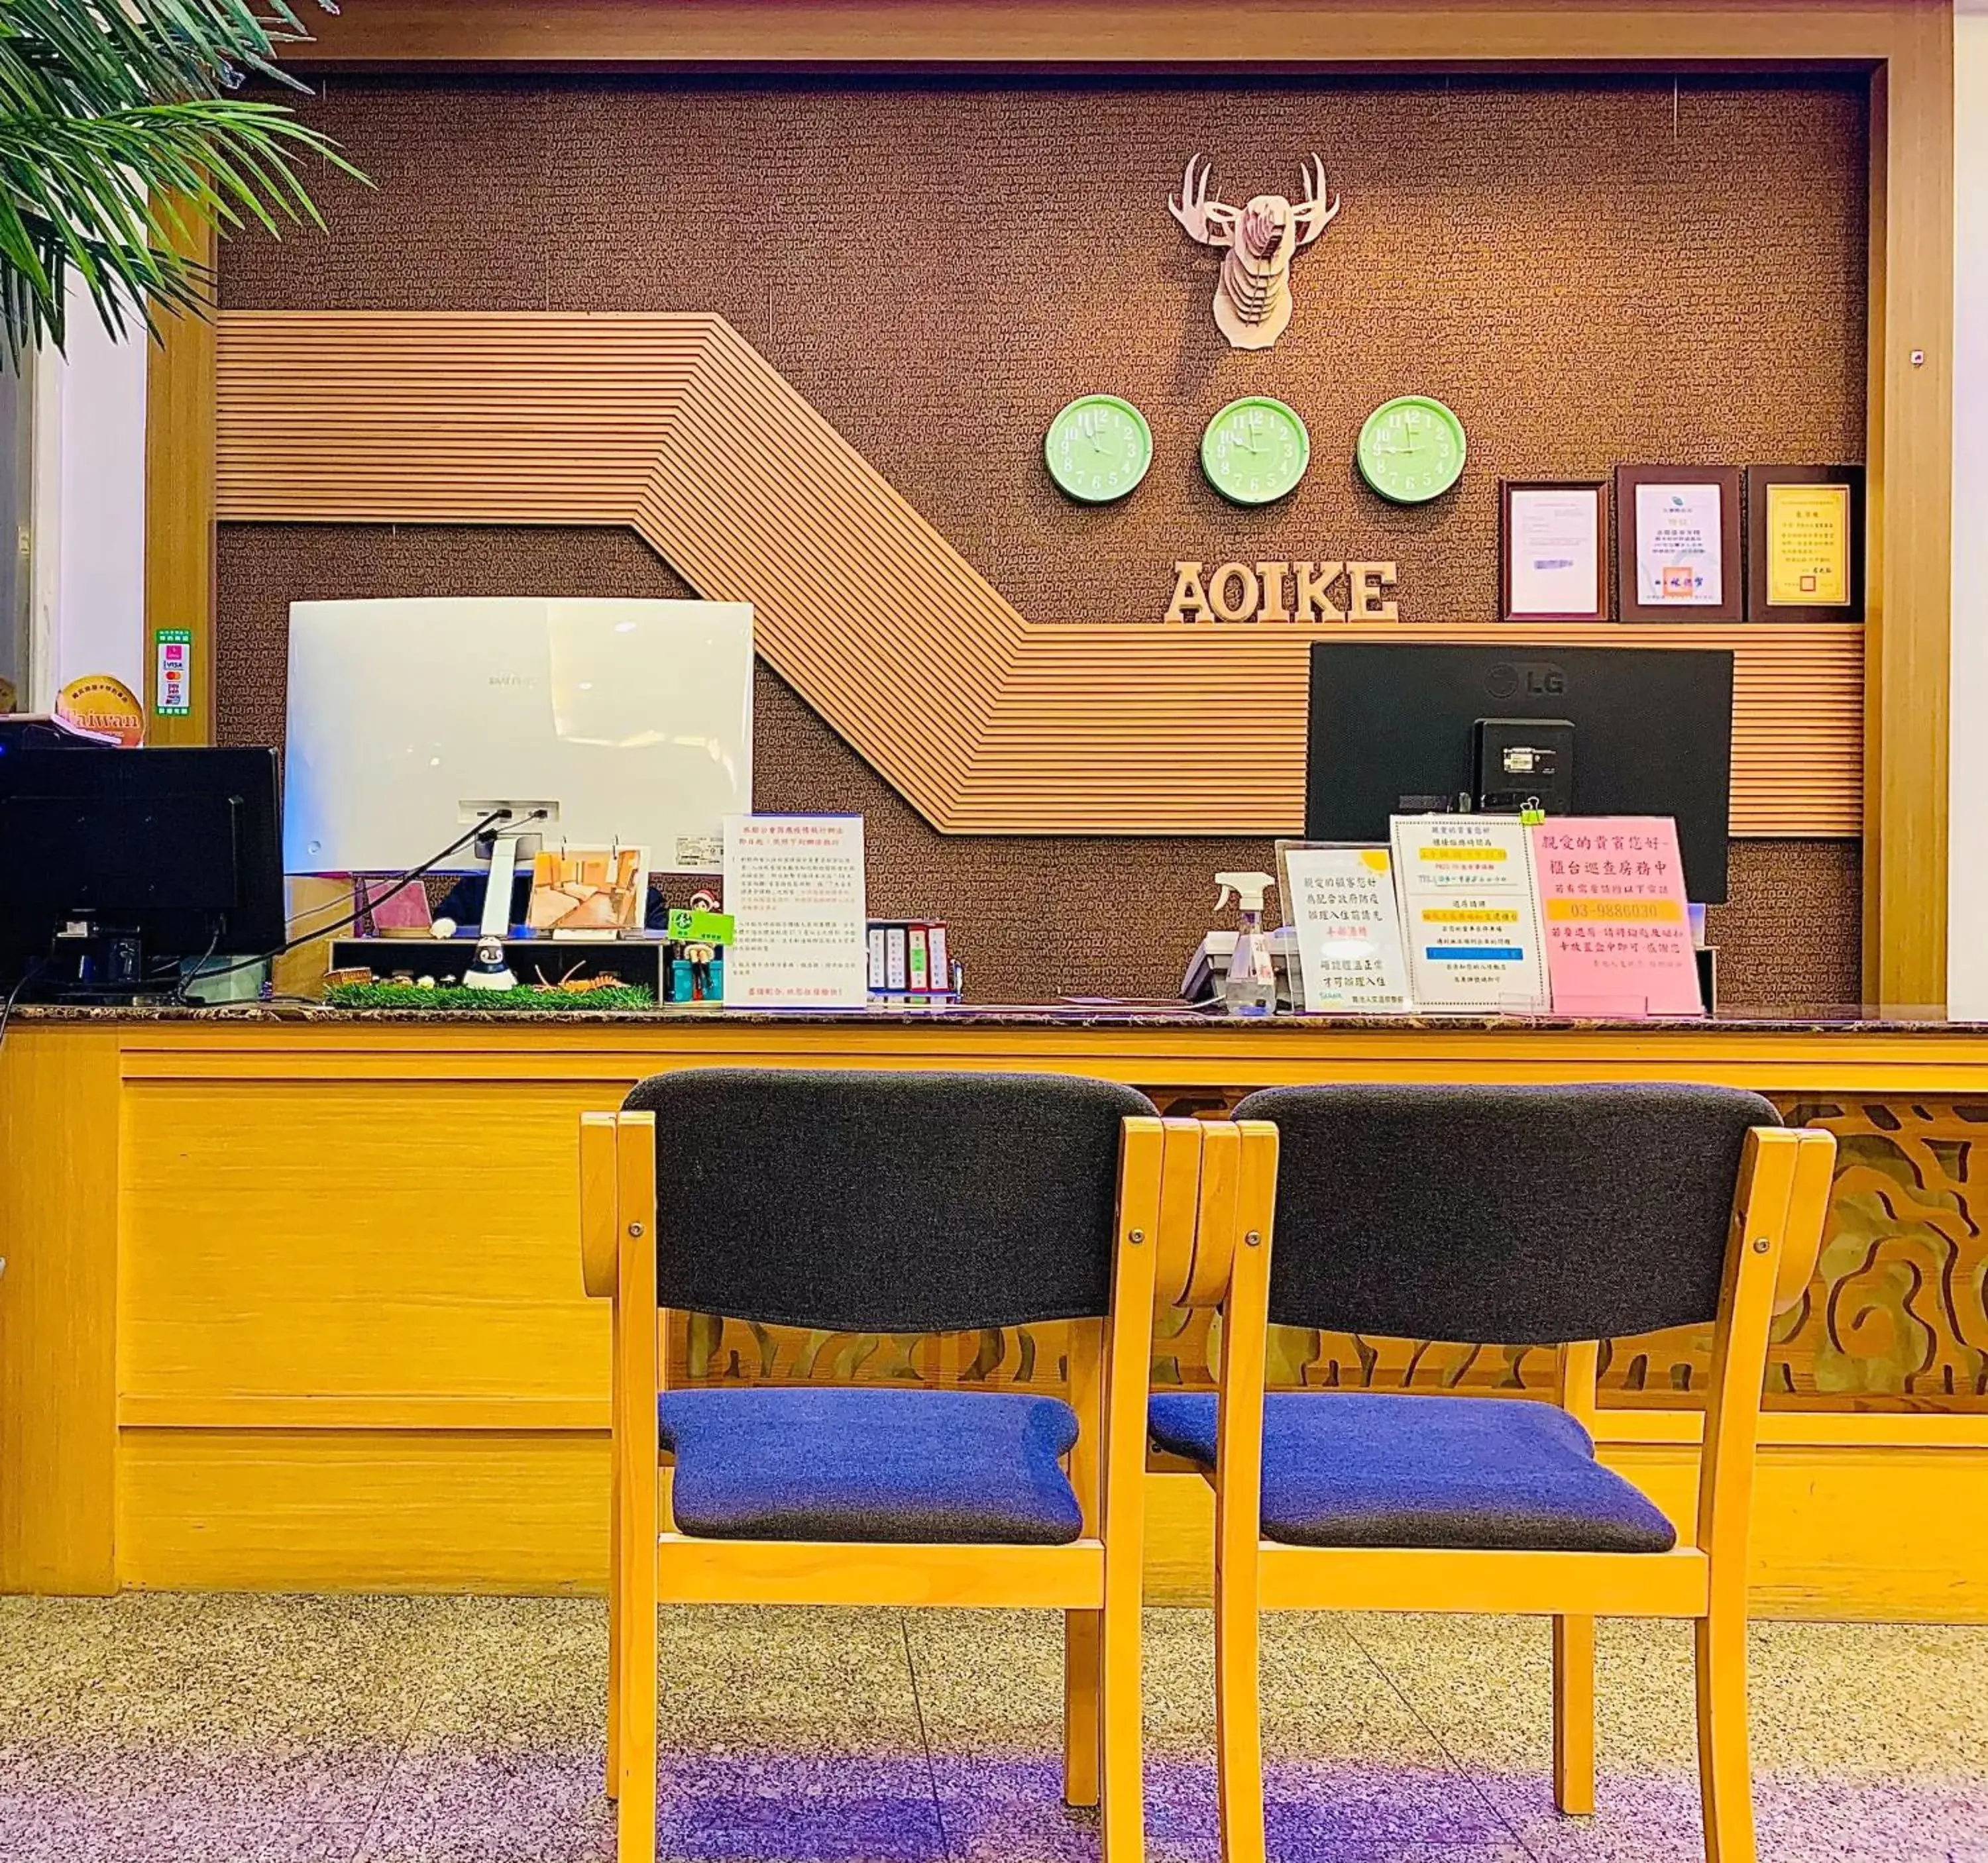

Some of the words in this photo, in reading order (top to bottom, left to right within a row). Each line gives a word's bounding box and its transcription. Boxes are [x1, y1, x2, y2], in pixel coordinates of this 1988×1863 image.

[1233, 415, 1244, 429] 11
[1389, 415, 1400, 427] 11
[1404, 410, 1419, 423] 12
[1065, 427, 1077, 440] 10
[1124, 427, 1133, 439] 2
[1279, 427, 1288, 440] 2
[1376, 429, 1388, 441] 10
[1436, 427, 1445, 440] 2
[1061, 441, 1069, 454] 9
[1128, 444, 1136, 457] 3
[1217, 445, 1225, 458] 9
[1284, 444, 1292, 457] 3
[1373, 443, 1380, 456] 9
[1441, 444, 1449, 457] 3
[1064, 458, 1073, 472] 8
[1122, 460, 1131, 473] 4
[1221, 462, 1229, 474] 8
[1280, 460, 1287, 474] 4
[1377, 459, 1385, 473] 8
[1435, 461, 1443, 474] 4
[1076, 470, 1084, 484] 7
[1092, 475, 1101, 489] 6
[1109, 472, 1117, 485] 5
[1233, 474, 1242, 487] 7
[1266, 473, 1276, 487] 5
[1389, 472, 1398, 485] 7
[1406, 476, 1414, 489] 6
[1423, 473, 1431, 486] 5
[1250, 478, 1258, 491] 6
[1165, 561, 1399, 622] AOIKE
[1527, 670, 1564, 694] LG
[1550, 861, 1667, 876] 櫃台巡查房務中
